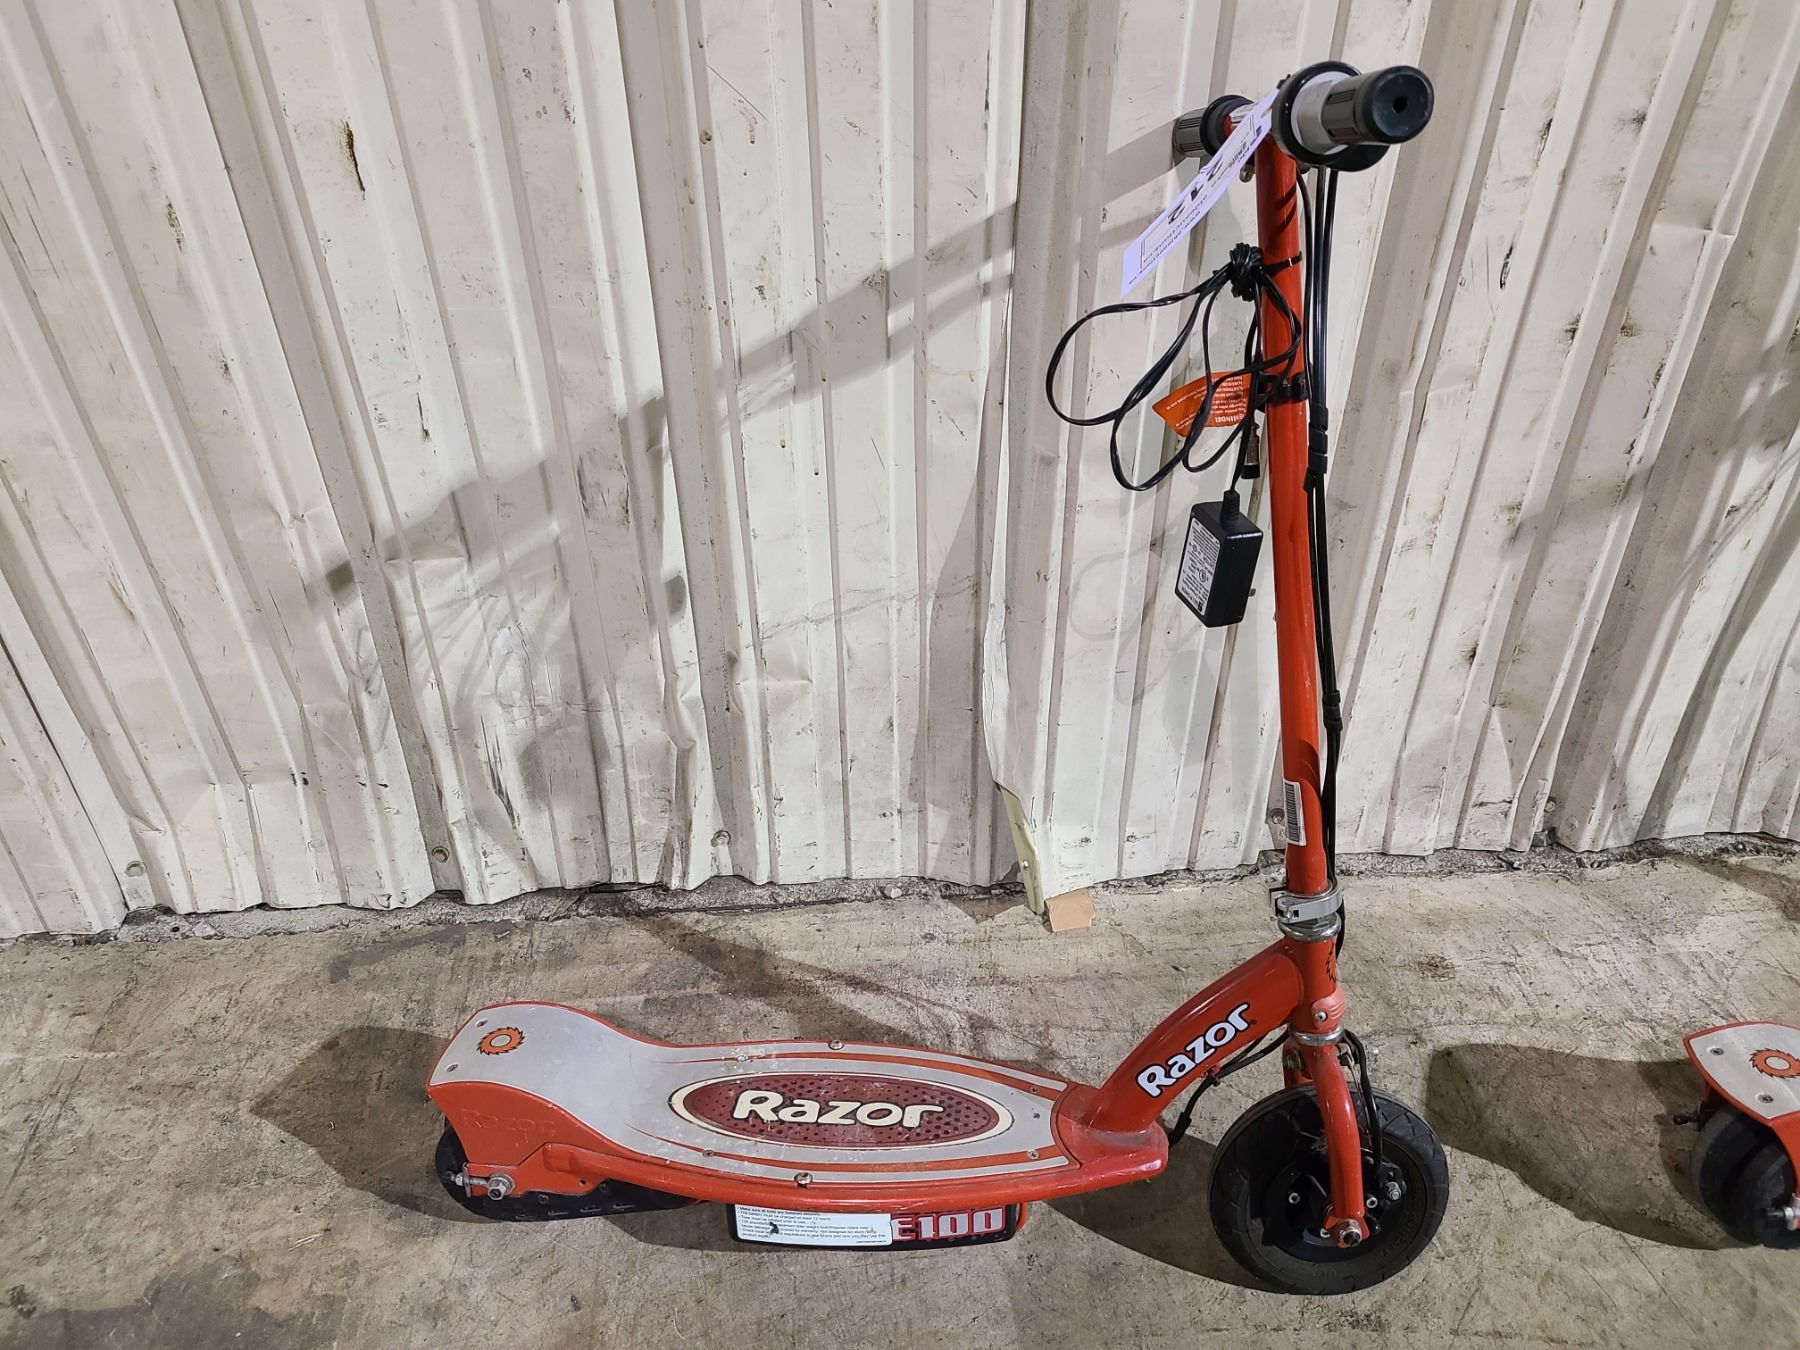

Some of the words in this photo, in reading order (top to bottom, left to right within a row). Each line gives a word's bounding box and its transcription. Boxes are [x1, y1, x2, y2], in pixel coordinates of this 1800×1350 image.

[1135, 1002, 1251, 1098] Razor
[732, 1089, 944, 1128] Razor
[891, 1207, 1005, 1242] E100
